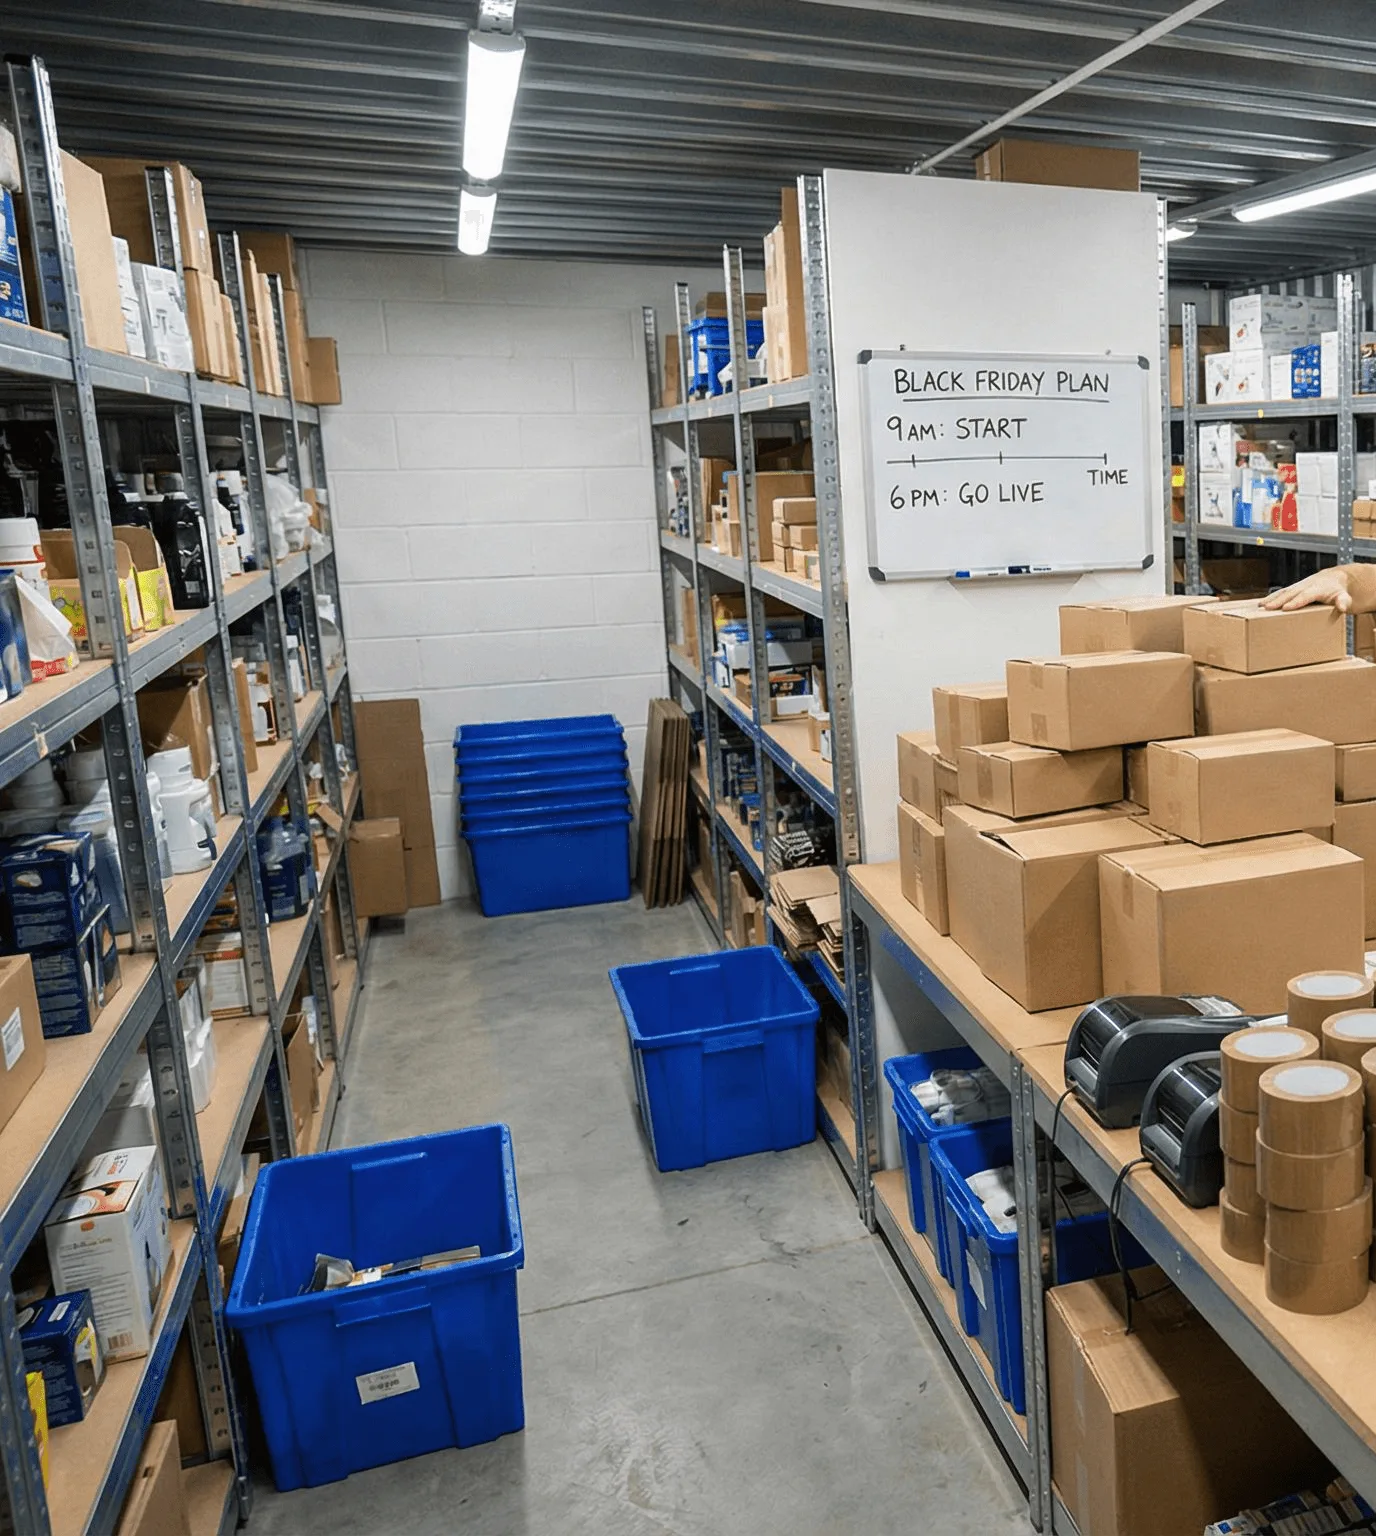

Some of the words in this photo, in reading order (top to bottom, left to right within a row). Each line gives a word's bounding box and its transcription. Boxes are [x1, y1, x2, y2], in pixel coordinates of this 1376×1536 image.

[894, 368, 965, 394] BLACK
[975, 370, 1046, 396] FRIDAY
[1057, 370, 1109, 393] PLAN
[955, 417, 1028, 440] START
[1087, 469, 1129, 486] TIME
[958, 482, 989, 507] GO
[998, 481, 1044, 503] LIVE
